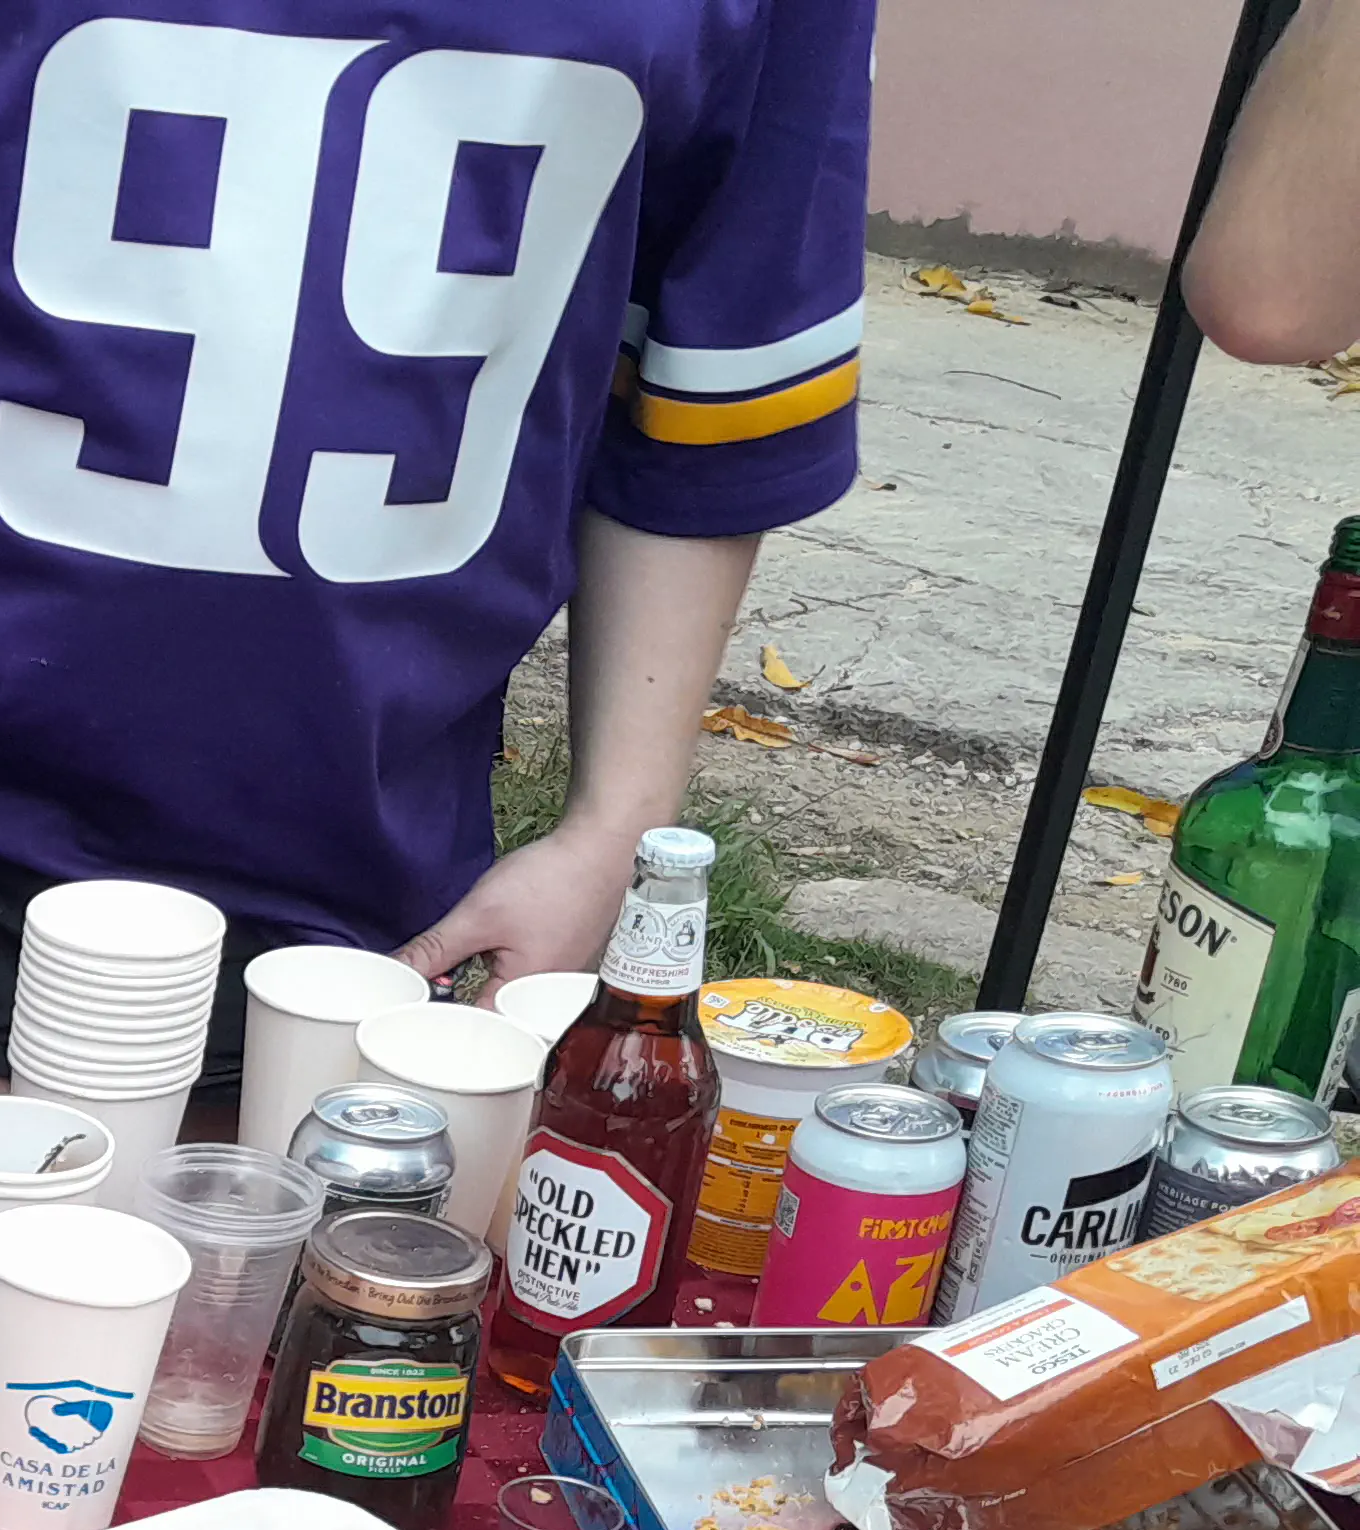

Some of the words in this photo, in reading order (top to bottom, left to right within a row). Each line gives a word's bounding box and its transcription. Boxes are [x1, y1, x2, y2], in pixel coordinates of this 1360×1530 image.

[514, 1187, 636, 1259] SPECKLED
[517, 1269, 580, 1301] DISTINCTIVE
[982, 1317, 1067, 1359] CRACKERS
[993, 1326, 1081, 1370] CREAM
[1030, 1349, 1091, 1376] TESCO
[313, 1382, 462, 1421] Branston
[0, 1450, 54, 1478] CASA
[61, 1461, 91, 1479] DE
[96, 1456, 117, 1474] LA
[342, 1453, 428, 1468] ORIGINAL
[2, 1472, 106, 1496] AMISTAD
